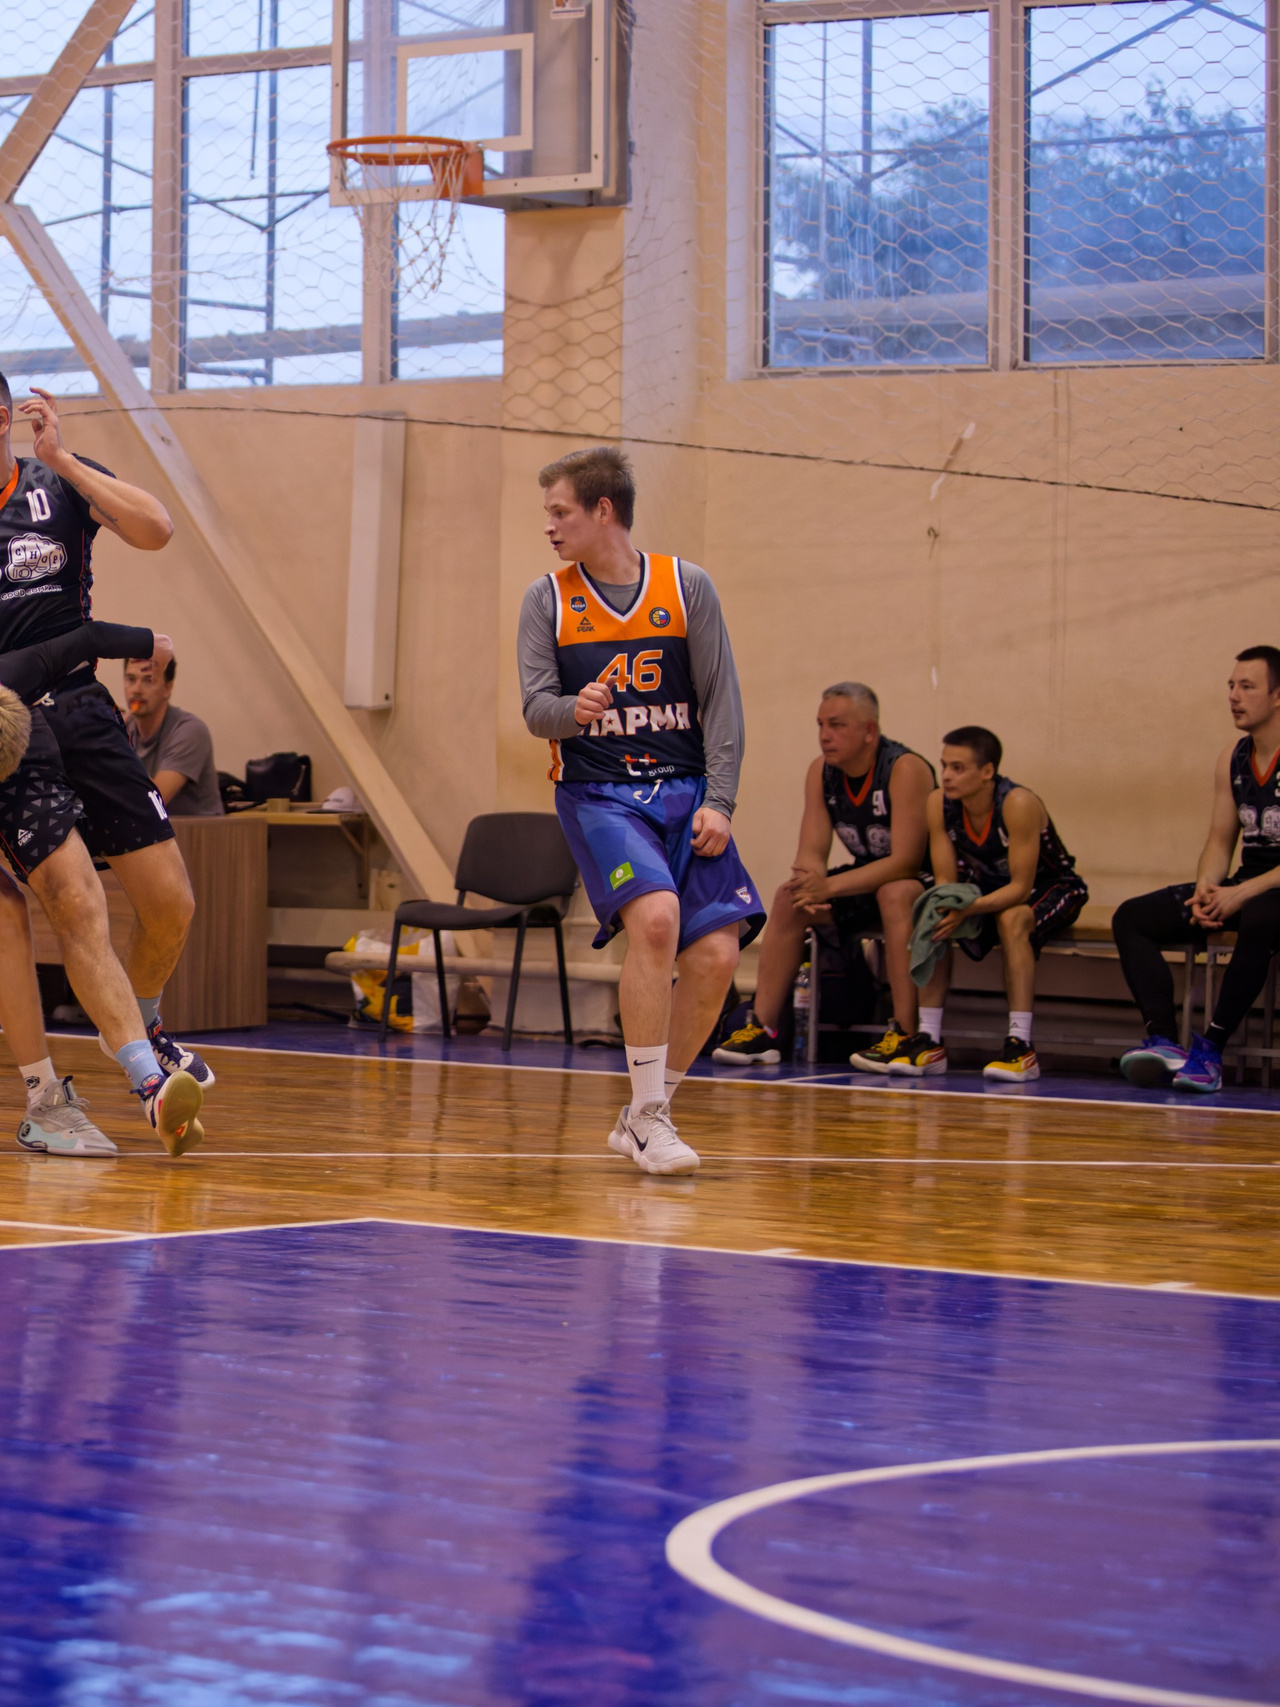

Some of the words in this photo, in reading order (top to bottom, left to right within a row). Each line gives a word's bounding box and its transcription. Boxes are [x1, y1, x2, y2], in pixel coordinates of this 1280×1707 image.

[25, 488, 51, 523] 10
[15, 548, 58, 564] CHOP
[596, 650, 663, 692] 46
